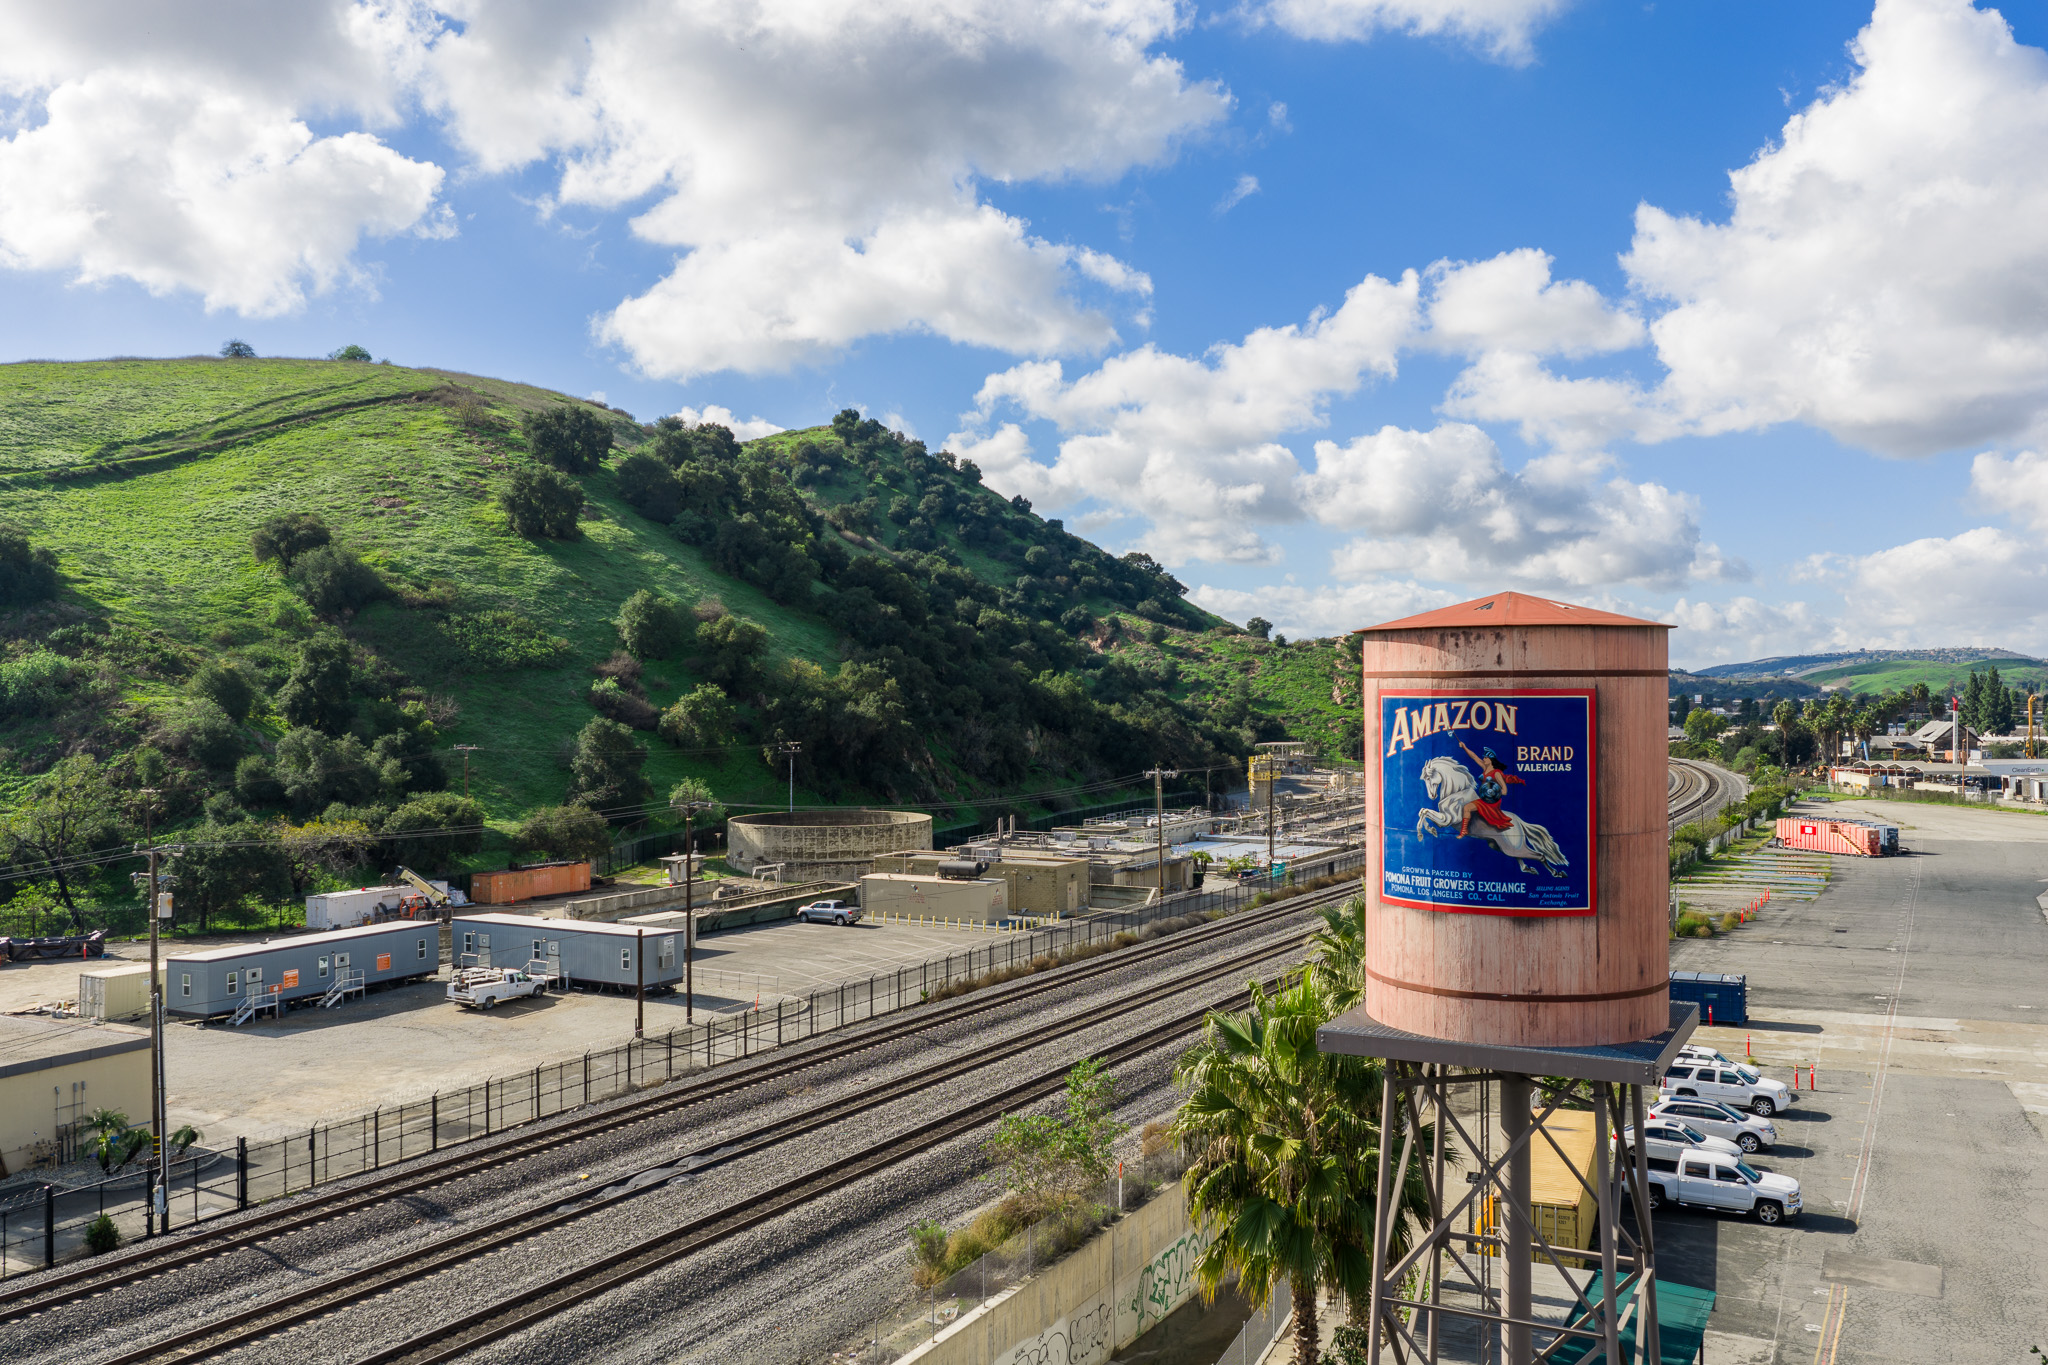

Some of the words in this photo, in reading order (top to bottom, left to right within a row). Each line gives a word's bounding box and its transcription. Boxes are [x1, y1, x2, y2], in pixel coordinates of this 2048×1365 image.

[1386, 700, 1518, 757] AMAZON
[1517, 746, 1574, 761] BRAND
[1516, 763, 1572, 772] VALENCIAS
[1402, 866, 1425, 875] GROWN
[1432, 870, 1460, 878] PACKED
[1385, 871, 1411, 885] POMONA
[1411, 875, 1432, 888] FRUIT
[1433, 878, 1475, 891] GROWERS
[1478, 881, 1526, 894] EXCHANGE
[1418, 888, 1430, 896] LOS
[1432, 890, 1463, 899] ANGELES
[1487, 893, 1506, 902] CAL.
